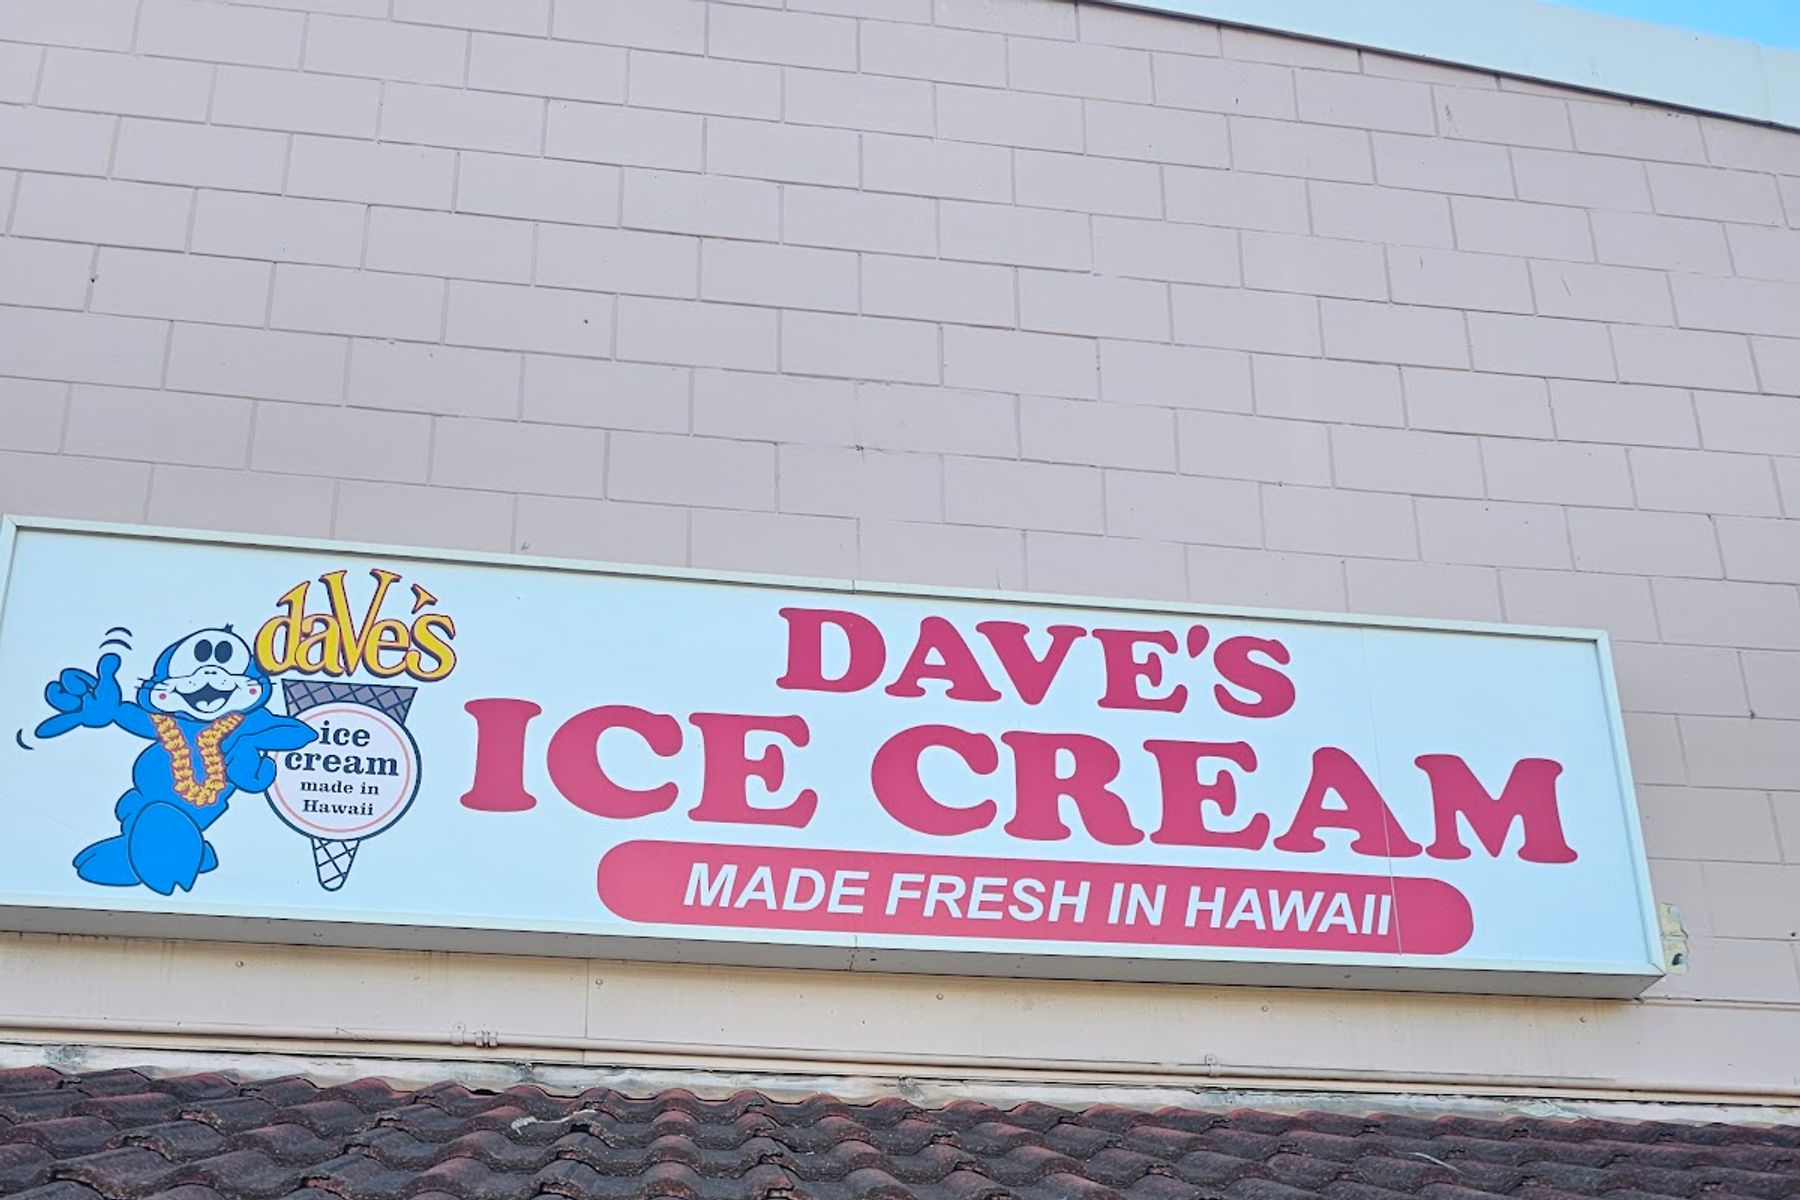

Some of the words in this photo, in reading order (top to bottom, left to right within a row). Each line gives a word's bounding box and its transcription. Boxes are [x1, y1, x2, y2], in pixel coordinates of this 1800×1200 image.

[776, 607, 1296, 718] DAVE'S
[317, 720, 371, 747] ice
[284, 748, 399, 777] cream
[300, 779, 354, 796] made
[359, 784, 380, 797] in
[460, 698, 818, 828] ICE
[871, 724, 1577, 864] CREAM
[302, 799, 375, 817] Hawaii
[683, 862, 870, 914] MADE
[885, 873, 1091, 925] FRESH
[1108, 883, 1166, 926] IN
[1185, 887, 1394, 936] HAWAII
